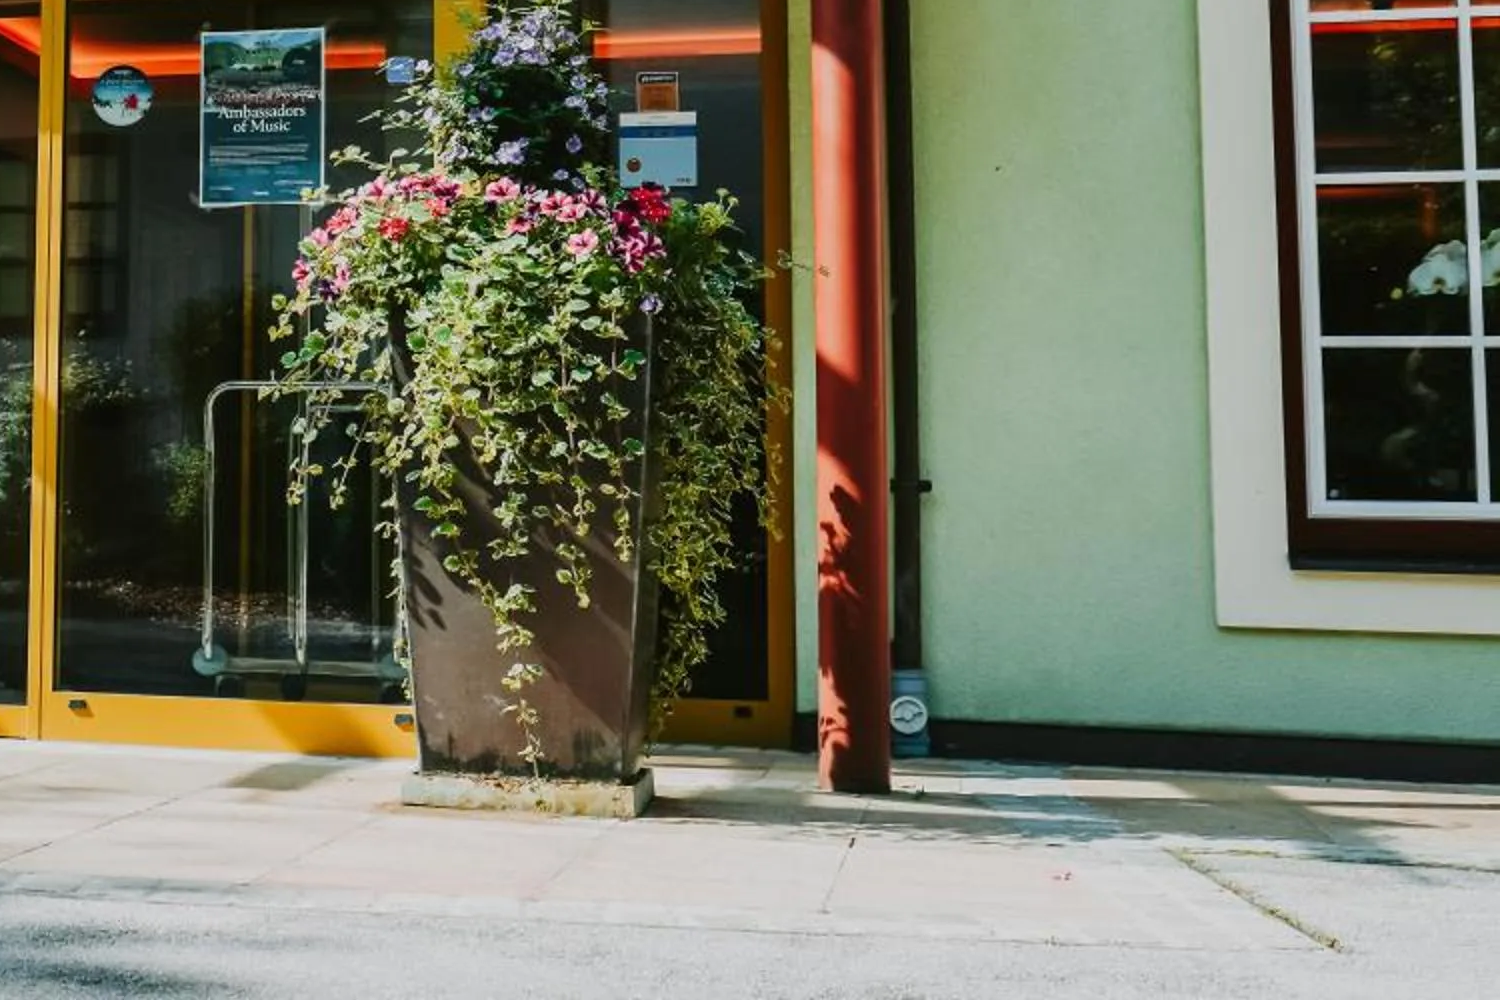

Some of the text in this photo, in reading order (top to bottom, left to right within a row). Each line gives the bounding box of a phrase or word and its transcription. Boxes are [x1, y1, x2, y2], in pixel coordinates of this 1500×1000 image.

[217, 103, 306, 120] Ambassadors
[233, 119, 291, 133] of Music
